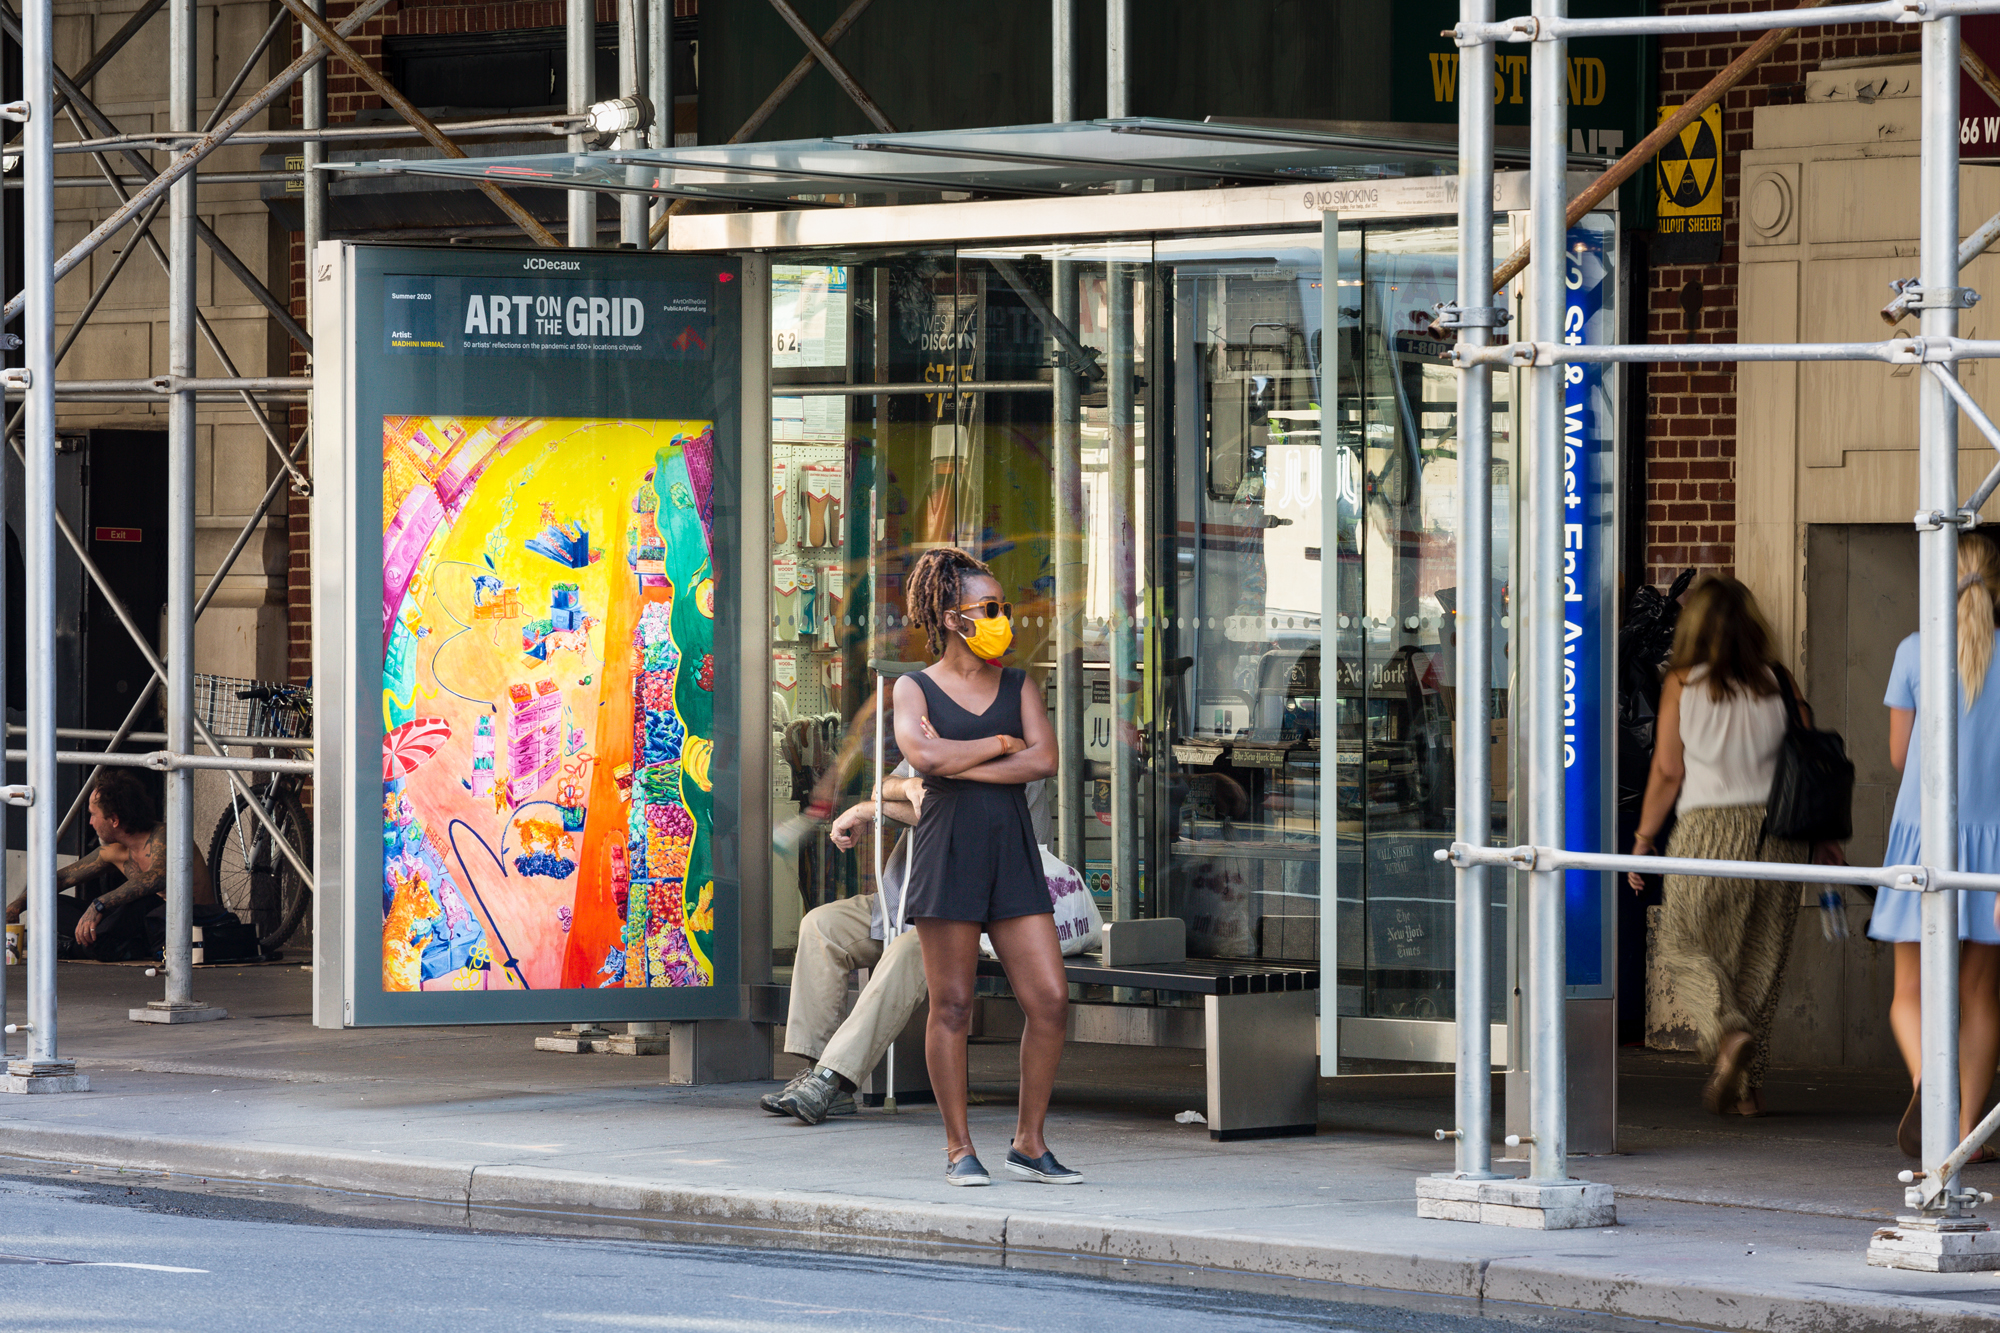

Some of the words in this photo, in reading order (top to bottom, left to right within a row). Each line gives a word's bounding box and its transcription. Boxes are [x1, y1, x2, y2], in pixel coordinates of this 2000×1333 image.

[1429, 53, 1527, 105] WST
[1960, 117, 1980, 144] 66
[1317, 190, 1332, 205] NO
[1334, 188, 1378, 204] SMOKING
[1658, 218, 1686, 234] ALLOUT
[1688, 217, 1722, 232] SHELTER
[523, 258, 580, 270] JCDecaux
[464, 294, 533, 335] ART
[536, 296, 562, 317] ON
[535, 318, 562, 335] THE
[566, 296, 644, 336] GRID
[922, 314, 960, 332] WEST
[541, 342, 568, 350] pandemic
[922, 332, 977, 351] DISCOUN
[1564, 403, 1583, 508] West
[111, 531, 126, 539] Exit
[1564, 524, 1582, 602] End
[1372, 663, 1406, 690] York
[1091, 717, 1110, 748] JU
[1234, 752, 1244, 760] The
[1245, 752, 1256, 761] New
[1256, 752, 1269, 764] York
[1270, 752, 1284, 761] Time
[1388, 832, 1399, 844] THE
[1377, 848, 1391, 860] WALL
[1392, 845, 1414, 859] STREET
[1396, 909, 1410, 923] The
[1056, 921, 1072, 941] ank
[1073, 917, 1089, 937] You
[1387, 926, 1404, 942] New
[1405, 924, 1424, 942] York
[1397, 944, 1420, 958] Times
